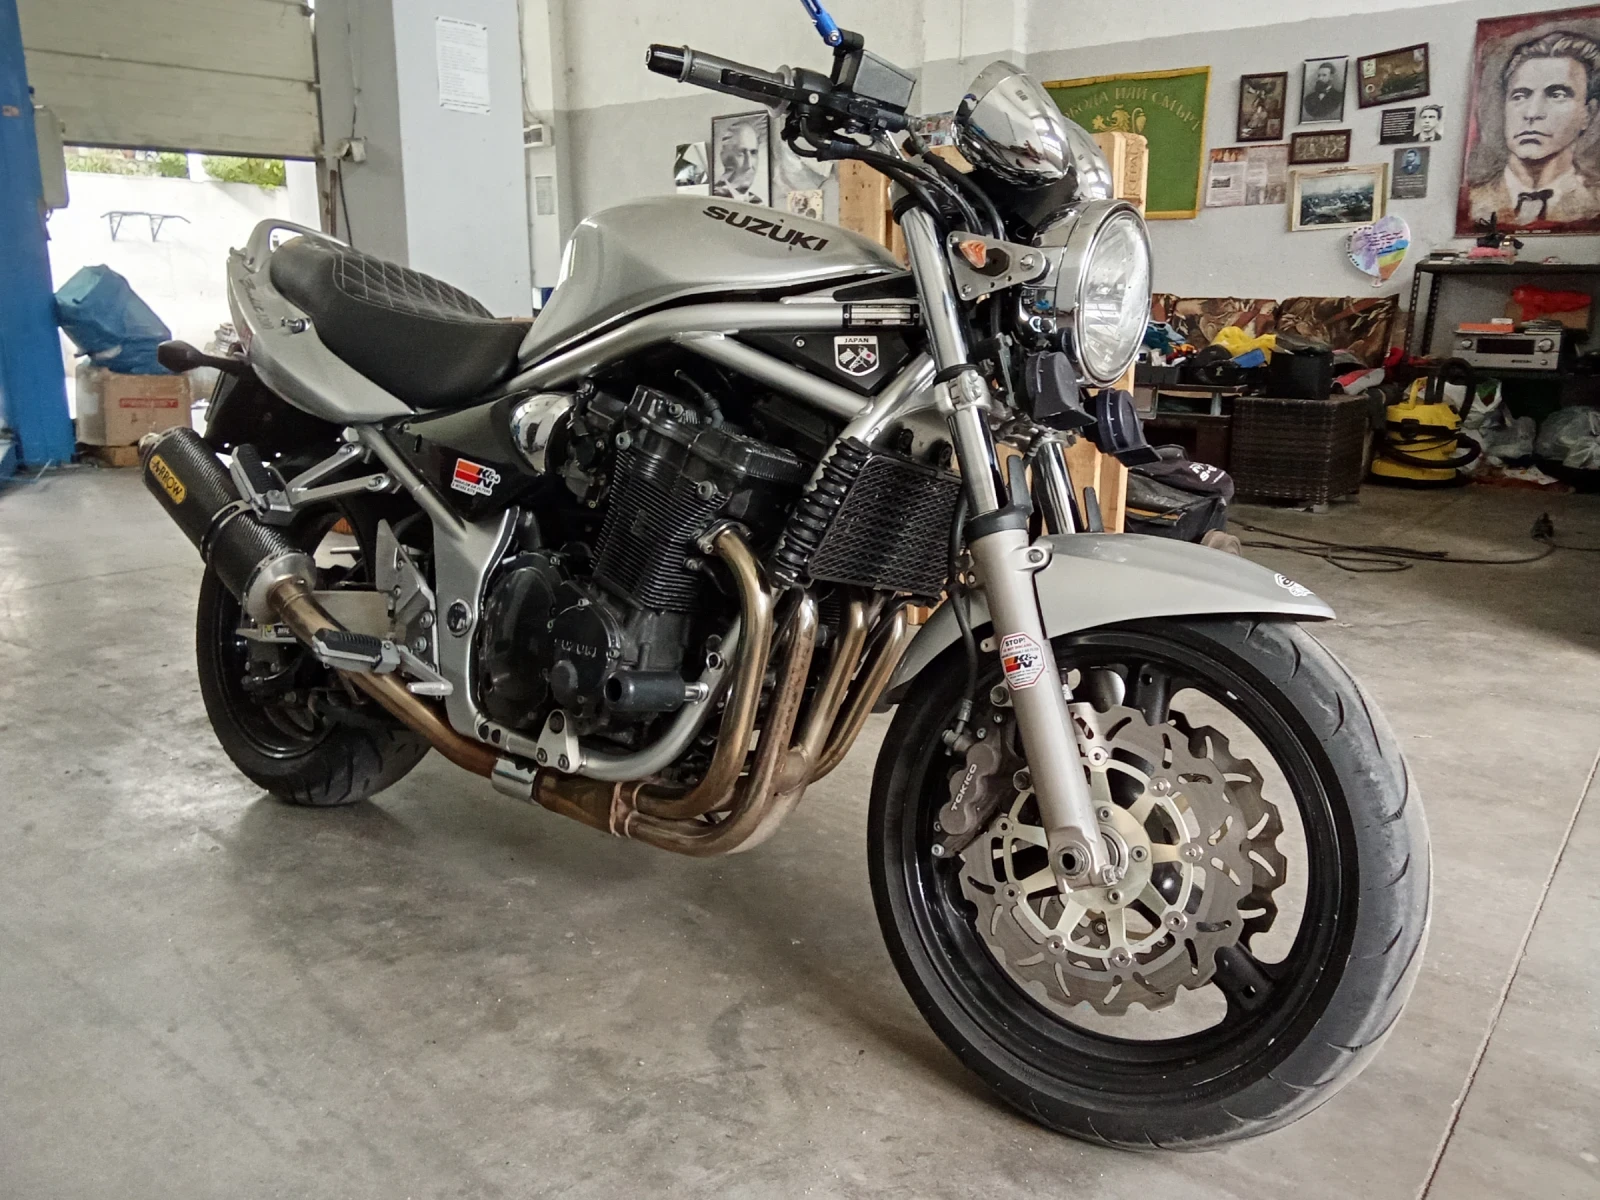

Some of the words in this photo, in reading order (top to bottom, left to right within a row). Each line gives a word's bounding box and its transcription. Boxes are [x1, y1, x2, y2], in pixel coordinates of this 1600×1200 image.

[1115, 86, 1148, 100] ИЛИ
[702, 205, 830, 252] SUZUKI
[151, 460, 184, 497] ARROW
[1005, 637, 1026, 647] STOP!
[951, 763, 977, 811] TOKICO
